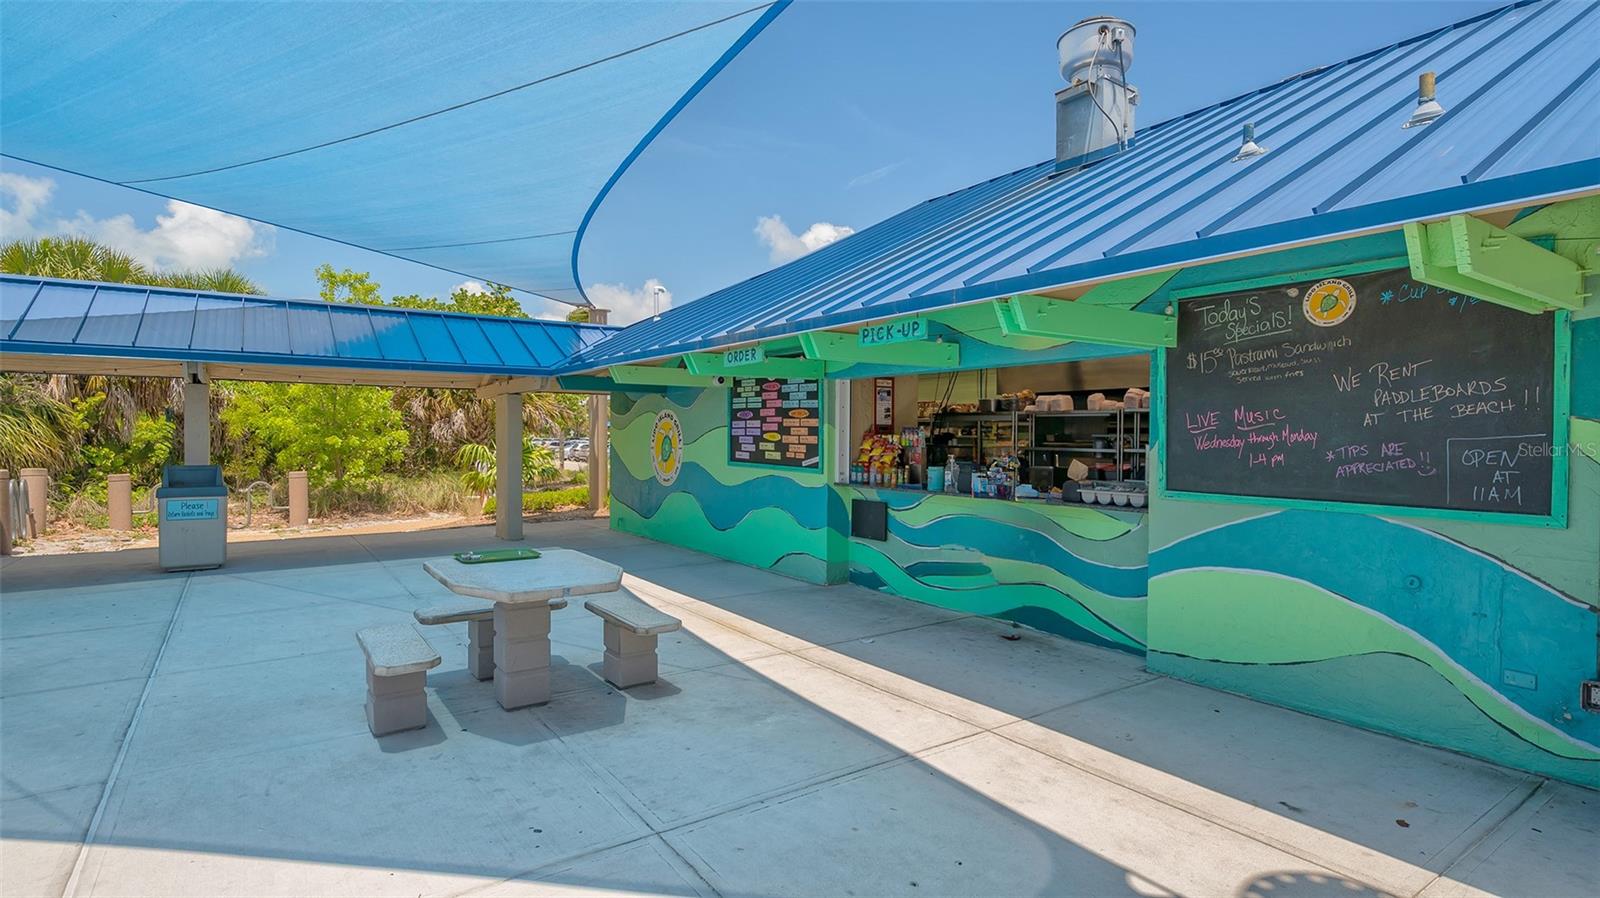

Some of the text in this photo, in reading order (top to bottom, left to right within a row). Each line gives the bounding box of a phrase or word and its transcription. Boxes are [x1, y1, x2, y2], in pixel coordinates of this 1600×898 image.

[862, 321, 920, 345] PICK-UP
[727, 348, 757, 363] ORDER
[1226, 347, 1279, 369] Pastrami
[1332, 359, 1433, 393] WE RENT
[1373, 377, 1508, 407] PADDLEBOARDS
[1185, 411, 1222, 429] LIVE
[1363, 412, 1386, 427] AT
[1396, 406, 1434, 423] THE
[1193, 424, 1320, 459] Wednesday through Monday
[1380, 442, 1409, 458] ARE
[1461, 447, 1520, 468] OPEN
[1492, 470, 1520, 484] AT
